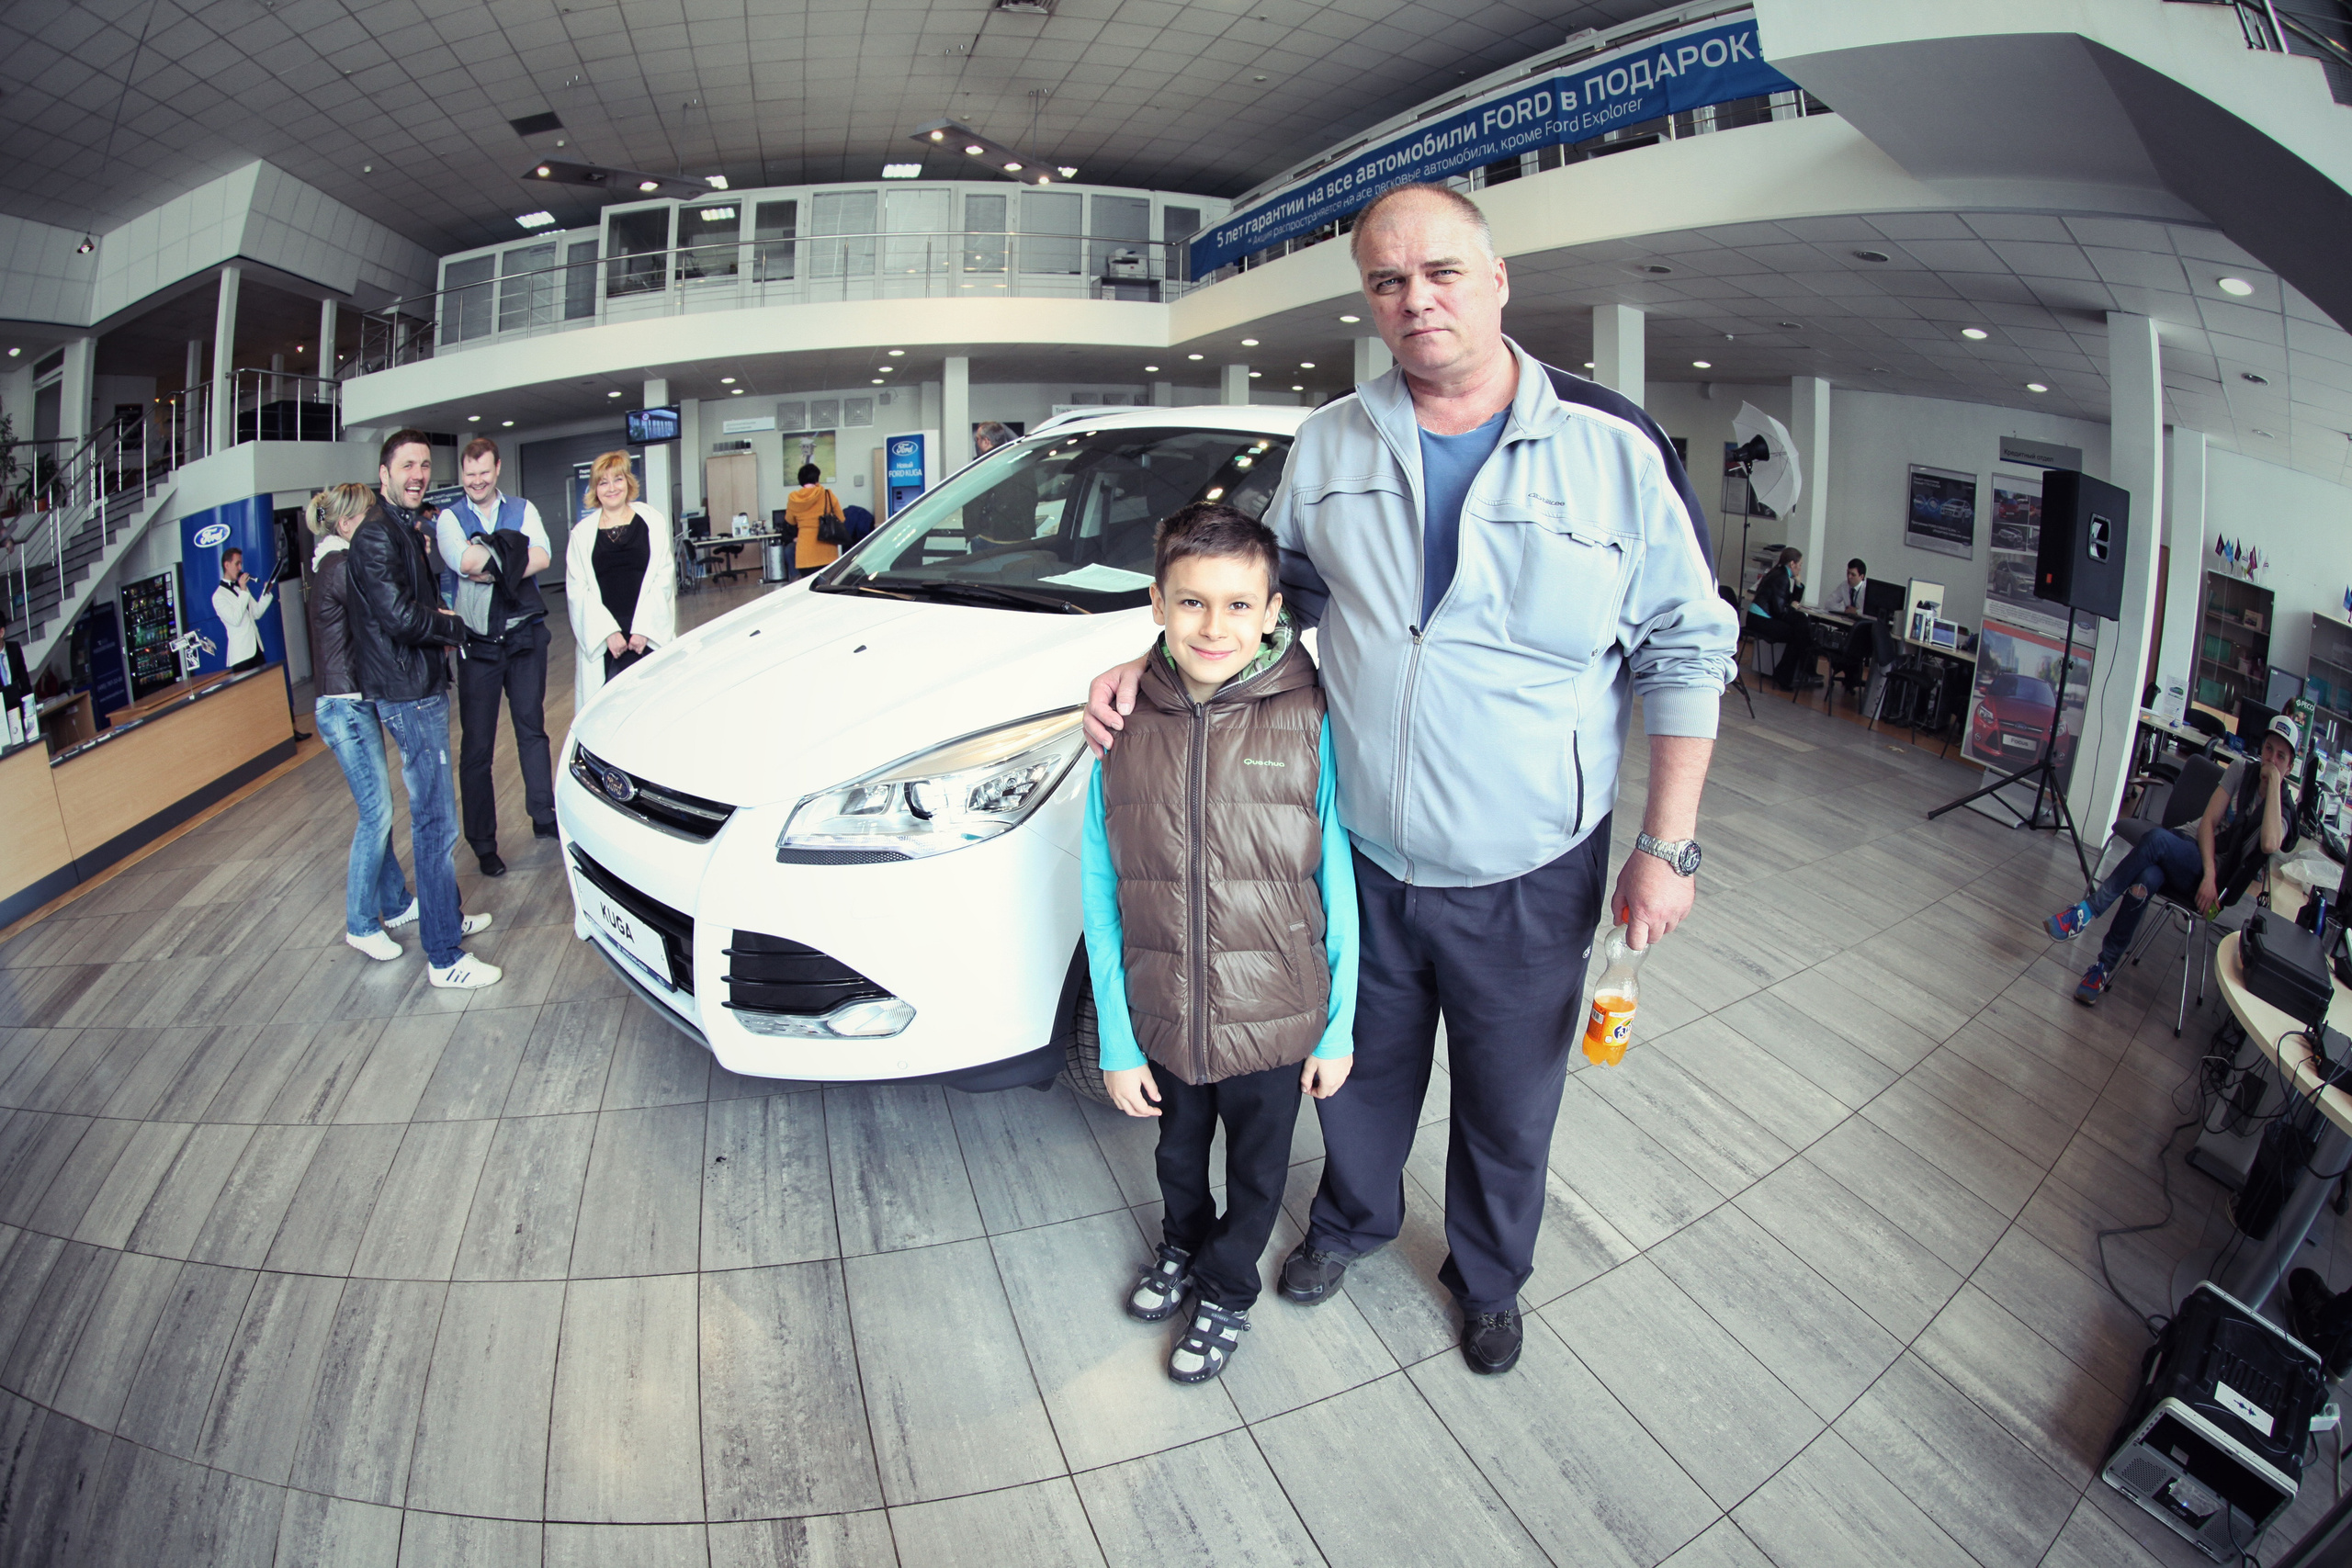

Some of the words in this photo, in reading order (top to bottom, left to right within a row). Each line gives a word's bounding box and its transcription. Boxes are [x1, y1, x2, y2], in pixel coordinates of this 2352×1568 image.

[1216, 231, 1224, 248] 5
[1225, 224, 1245, 245] лет
[1245, 197, 1305, 235] гарантии
[1307, 186, 1324, 209] на
[1327, 173, 1352, 198] все
[1356, 121, 1477, 185] автомобили
[1483, 91, 1553, 134] FORD
[1560, 91, 1577, 111] в
[1272, 200, 1342, 237] распространяется
[1343, 195, 1355, 208] на
[1356, 186, 1373, 202] все
[1423, 140, 1498, 176] автомобили,
[1500, 127, 1543, 153] кроме
[1544, 112, 1579, 137] Ford
[1582, 97, 1644, 130] Explorer
[894, 442, 916, 456] Ford
[2004, 448, 2036, 459] Кредитный
[2036, 455, 2054, 463] отдел
[888, 469, 905, 478] FORD
[905, 468, 922, 477] KUGA
[896, 460, 913, 469] Новый
[198, 525, 226, 547] Ford
[1243, 758, 1285, 768] Quechua
[605, 771, 628, 798] Ford
[599, 901, 635, 944] KUGA
